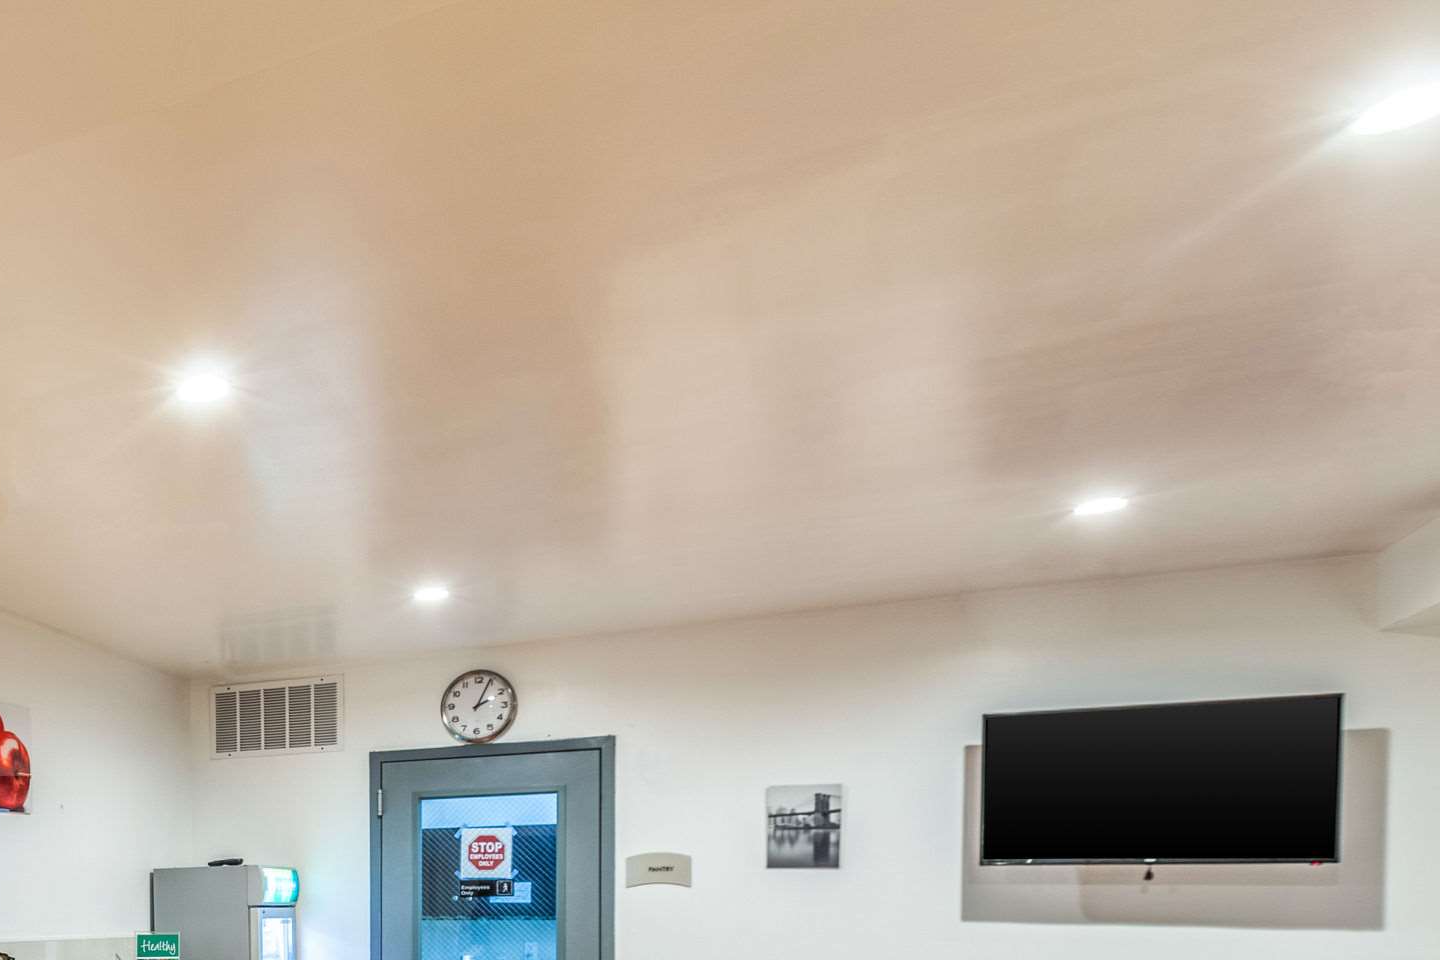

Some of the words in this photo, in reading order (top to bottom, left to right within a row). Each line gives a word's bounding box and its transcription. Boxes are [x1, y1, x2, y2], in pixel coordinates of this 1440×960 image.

[474, 676, 484, 684] 12
[452, 690, 461, 698] 10
[500, 701, 508, 709] 3
[471, 841, 503, 854] STOP
[140, 939, 176, 956] Healthy
